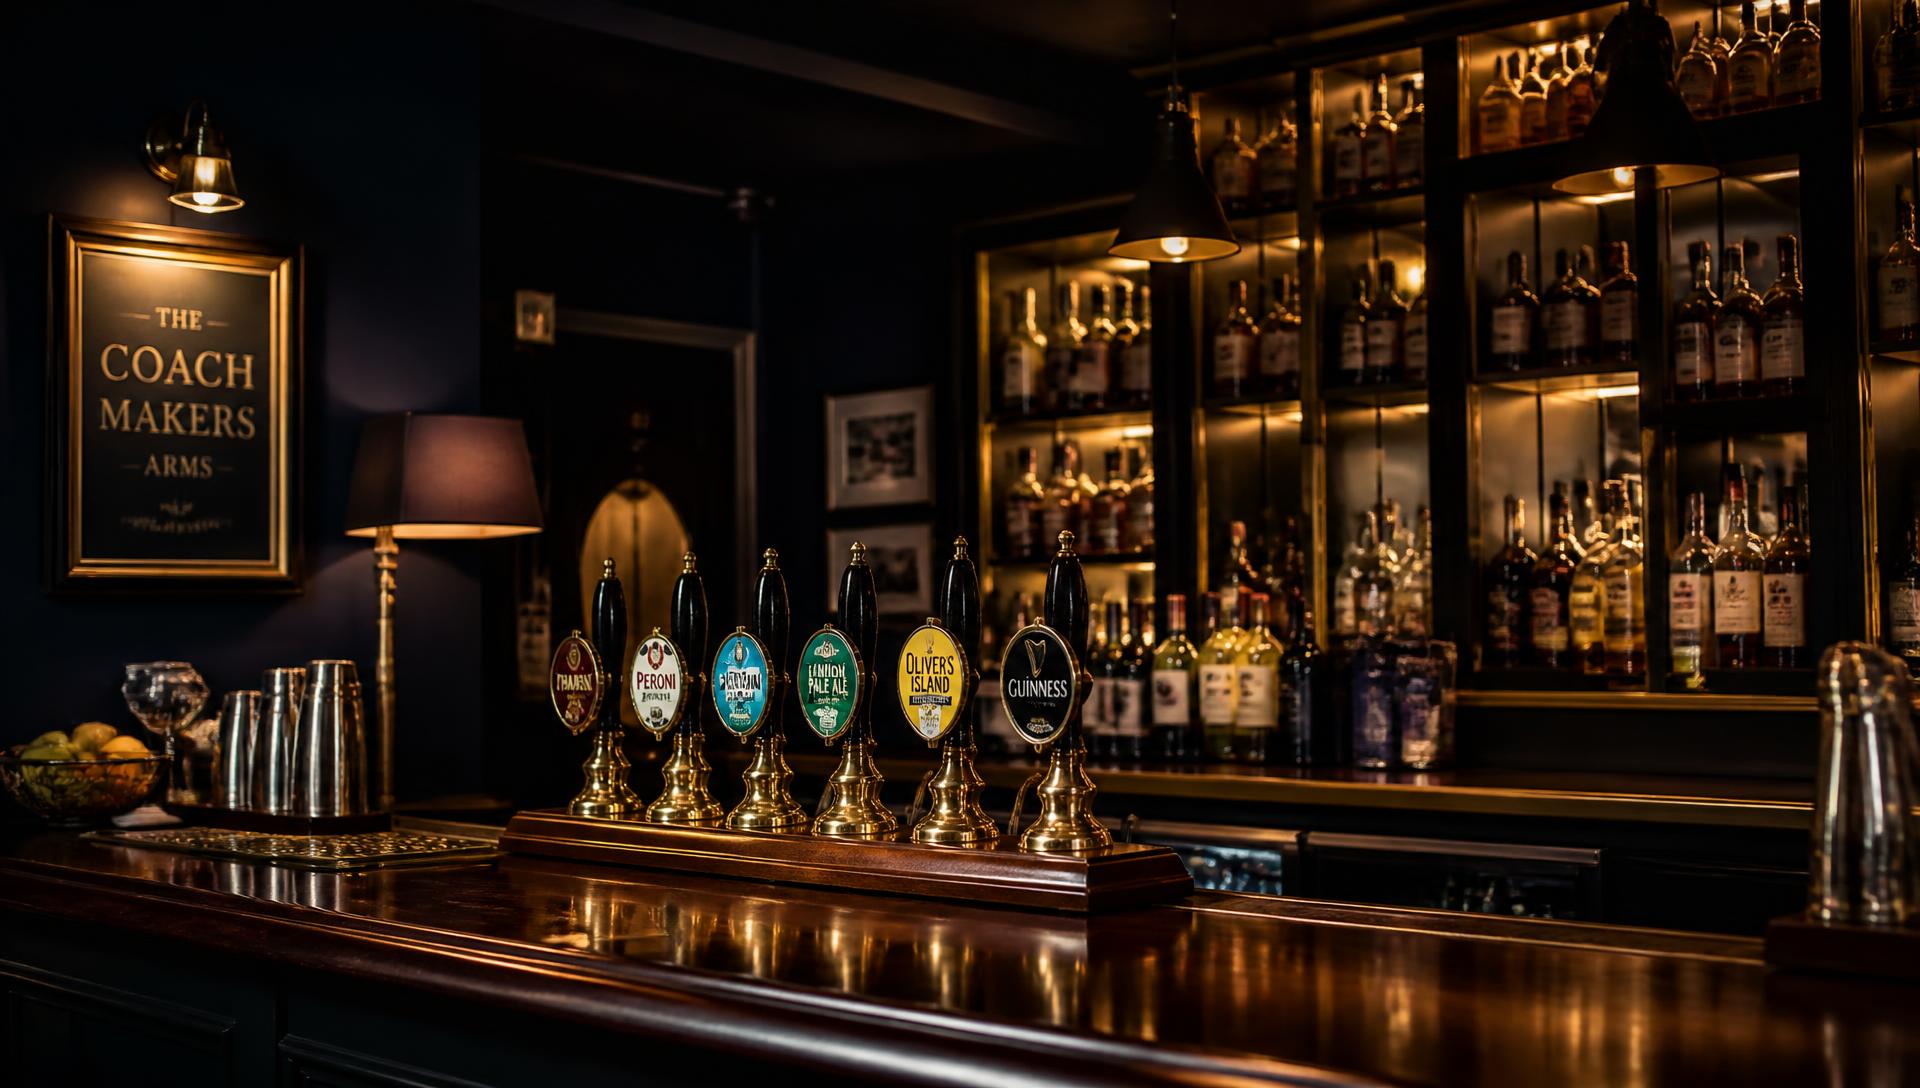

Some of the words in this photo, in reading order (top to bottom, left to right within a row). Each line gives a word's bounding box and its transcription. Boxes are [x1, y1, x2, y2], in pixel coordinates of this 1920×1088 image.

[154, 306, 204, 331] THE
[100, 343, 255, 391] COACH
[99, 397, 256, 441] MAKERS
[143, 452, 214, 480] ARMS
[637, 671, 676, 690] PERONI
[911, 675, 950, 694] ISLAND
[1008, 676, 1068, 698] GUINNESS
